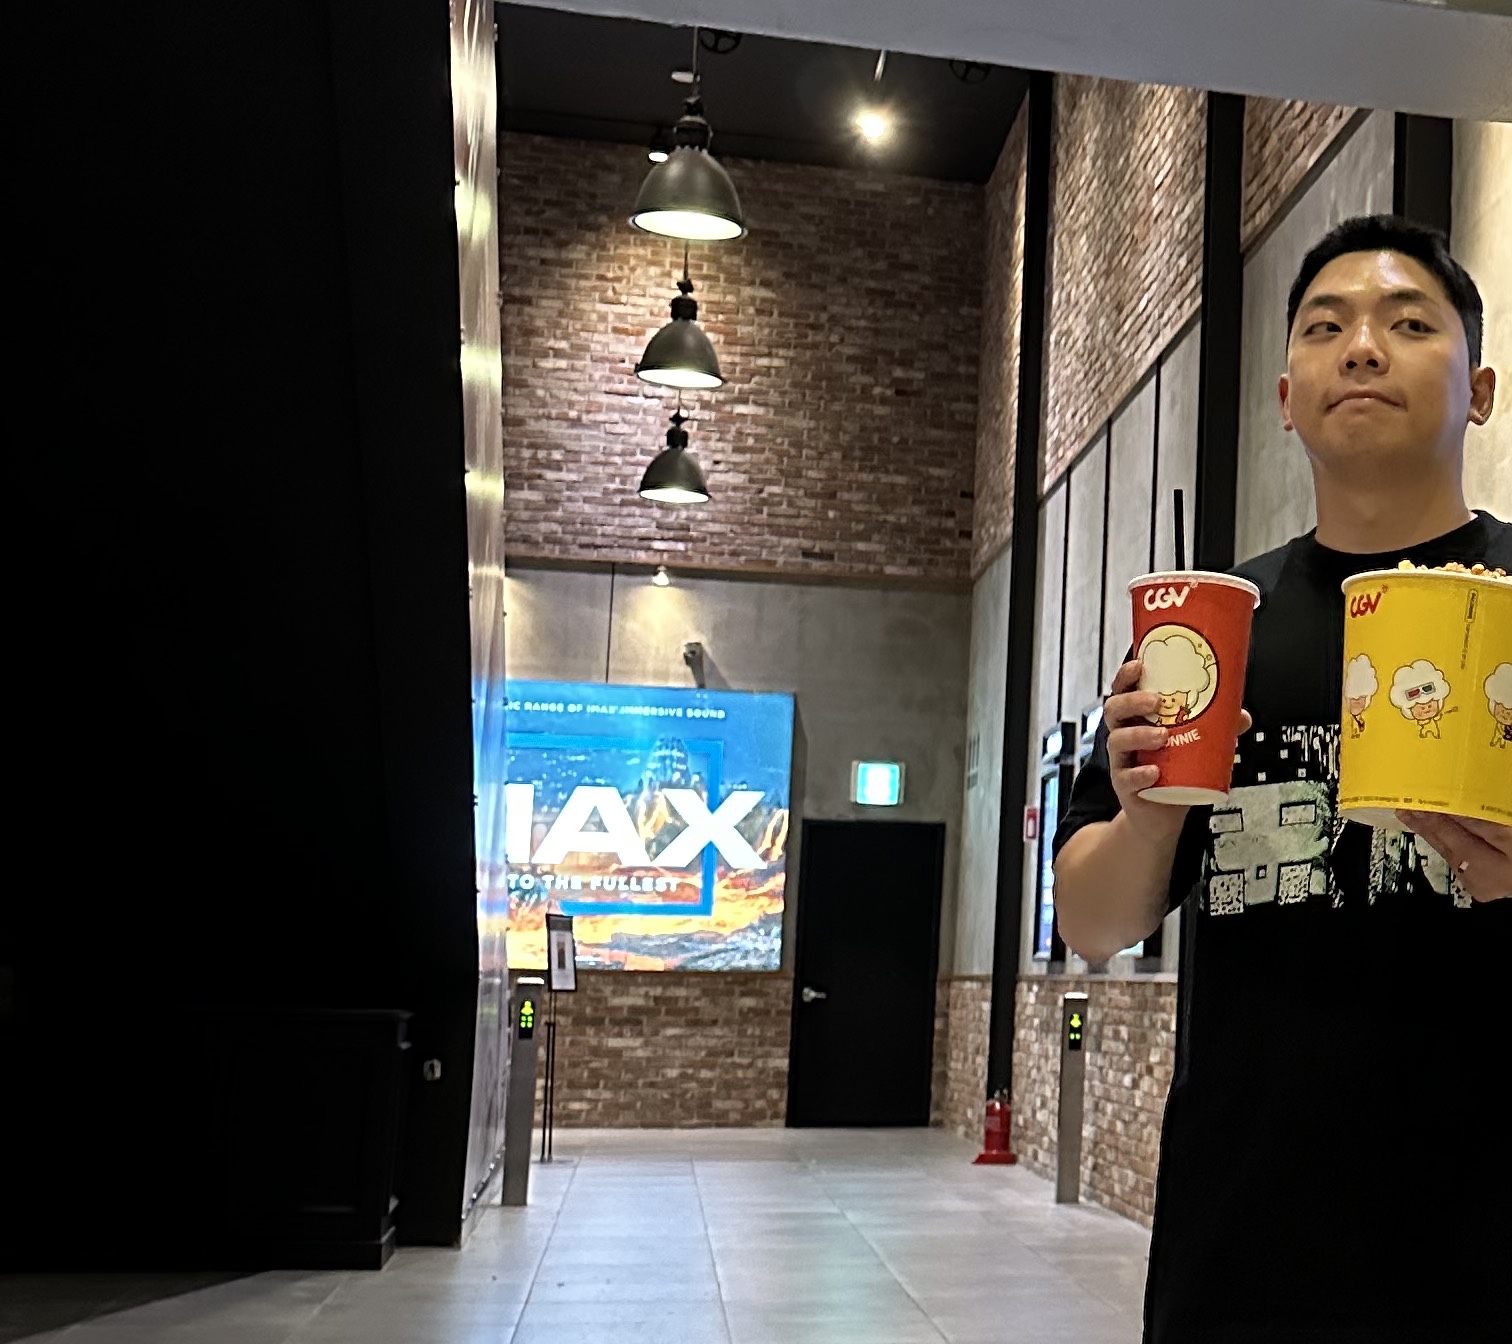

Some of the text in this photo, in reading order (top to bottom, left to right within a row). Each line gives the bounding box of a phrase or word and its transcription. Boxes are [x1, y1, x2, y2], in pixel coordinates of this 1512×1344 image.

[1144, 586, 1190, 611] CGV
[1350, 592, 1381, 618] CGV
[524, 702, 564, 713] RANGE
[568, 703, 582, 713] OF
[686, 707, 726, 719] SOUND
[508, 874, 682, 892] TO THE FULLEST
